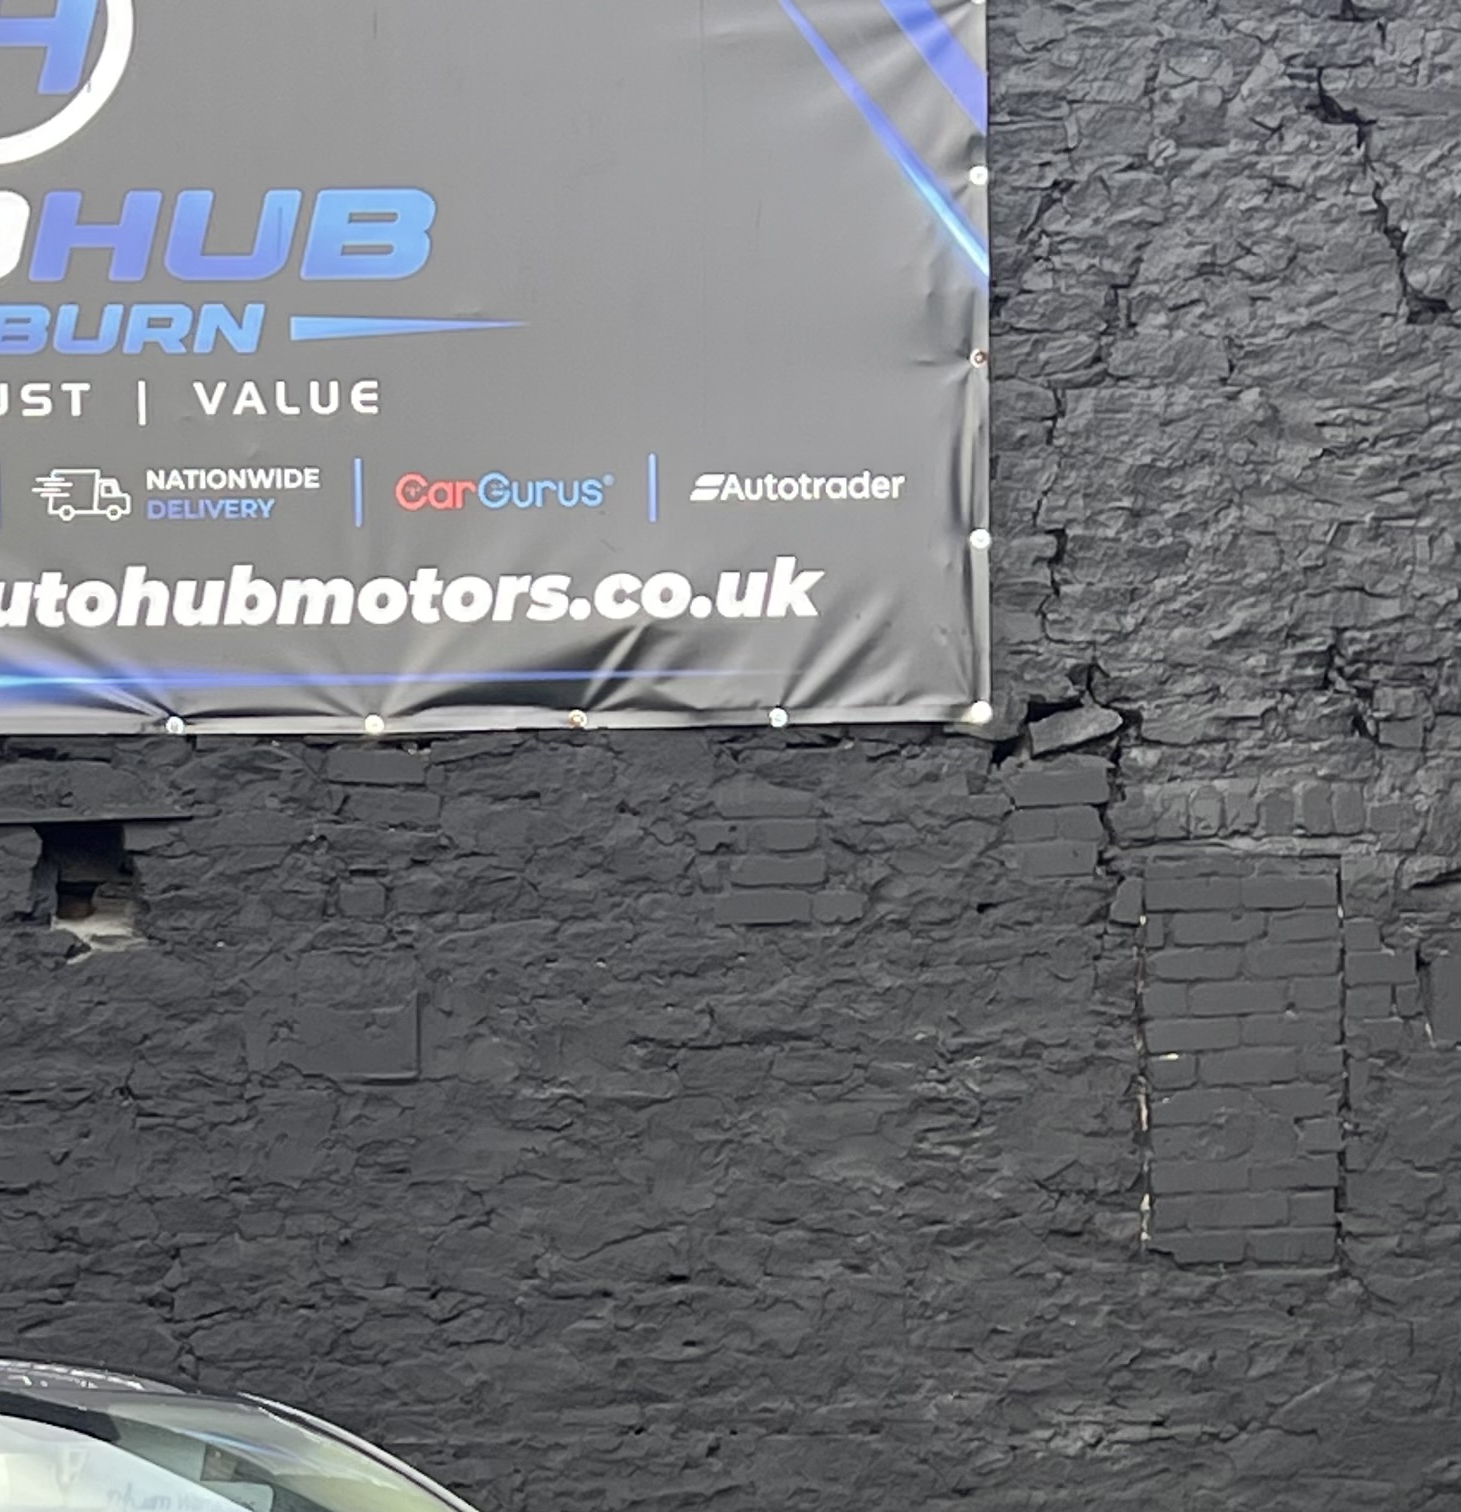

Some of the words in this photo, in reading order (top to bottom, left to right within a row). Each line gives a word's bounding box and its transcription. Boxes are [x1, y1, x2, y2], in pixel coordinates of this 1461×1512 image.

[193, 381, 378, 414] VALUE
[147, 468, 319, 489] NATIONWIDE
[720, 471, 905, 500] Autotrader
[148, 499, 274, 518] DELIVERY
